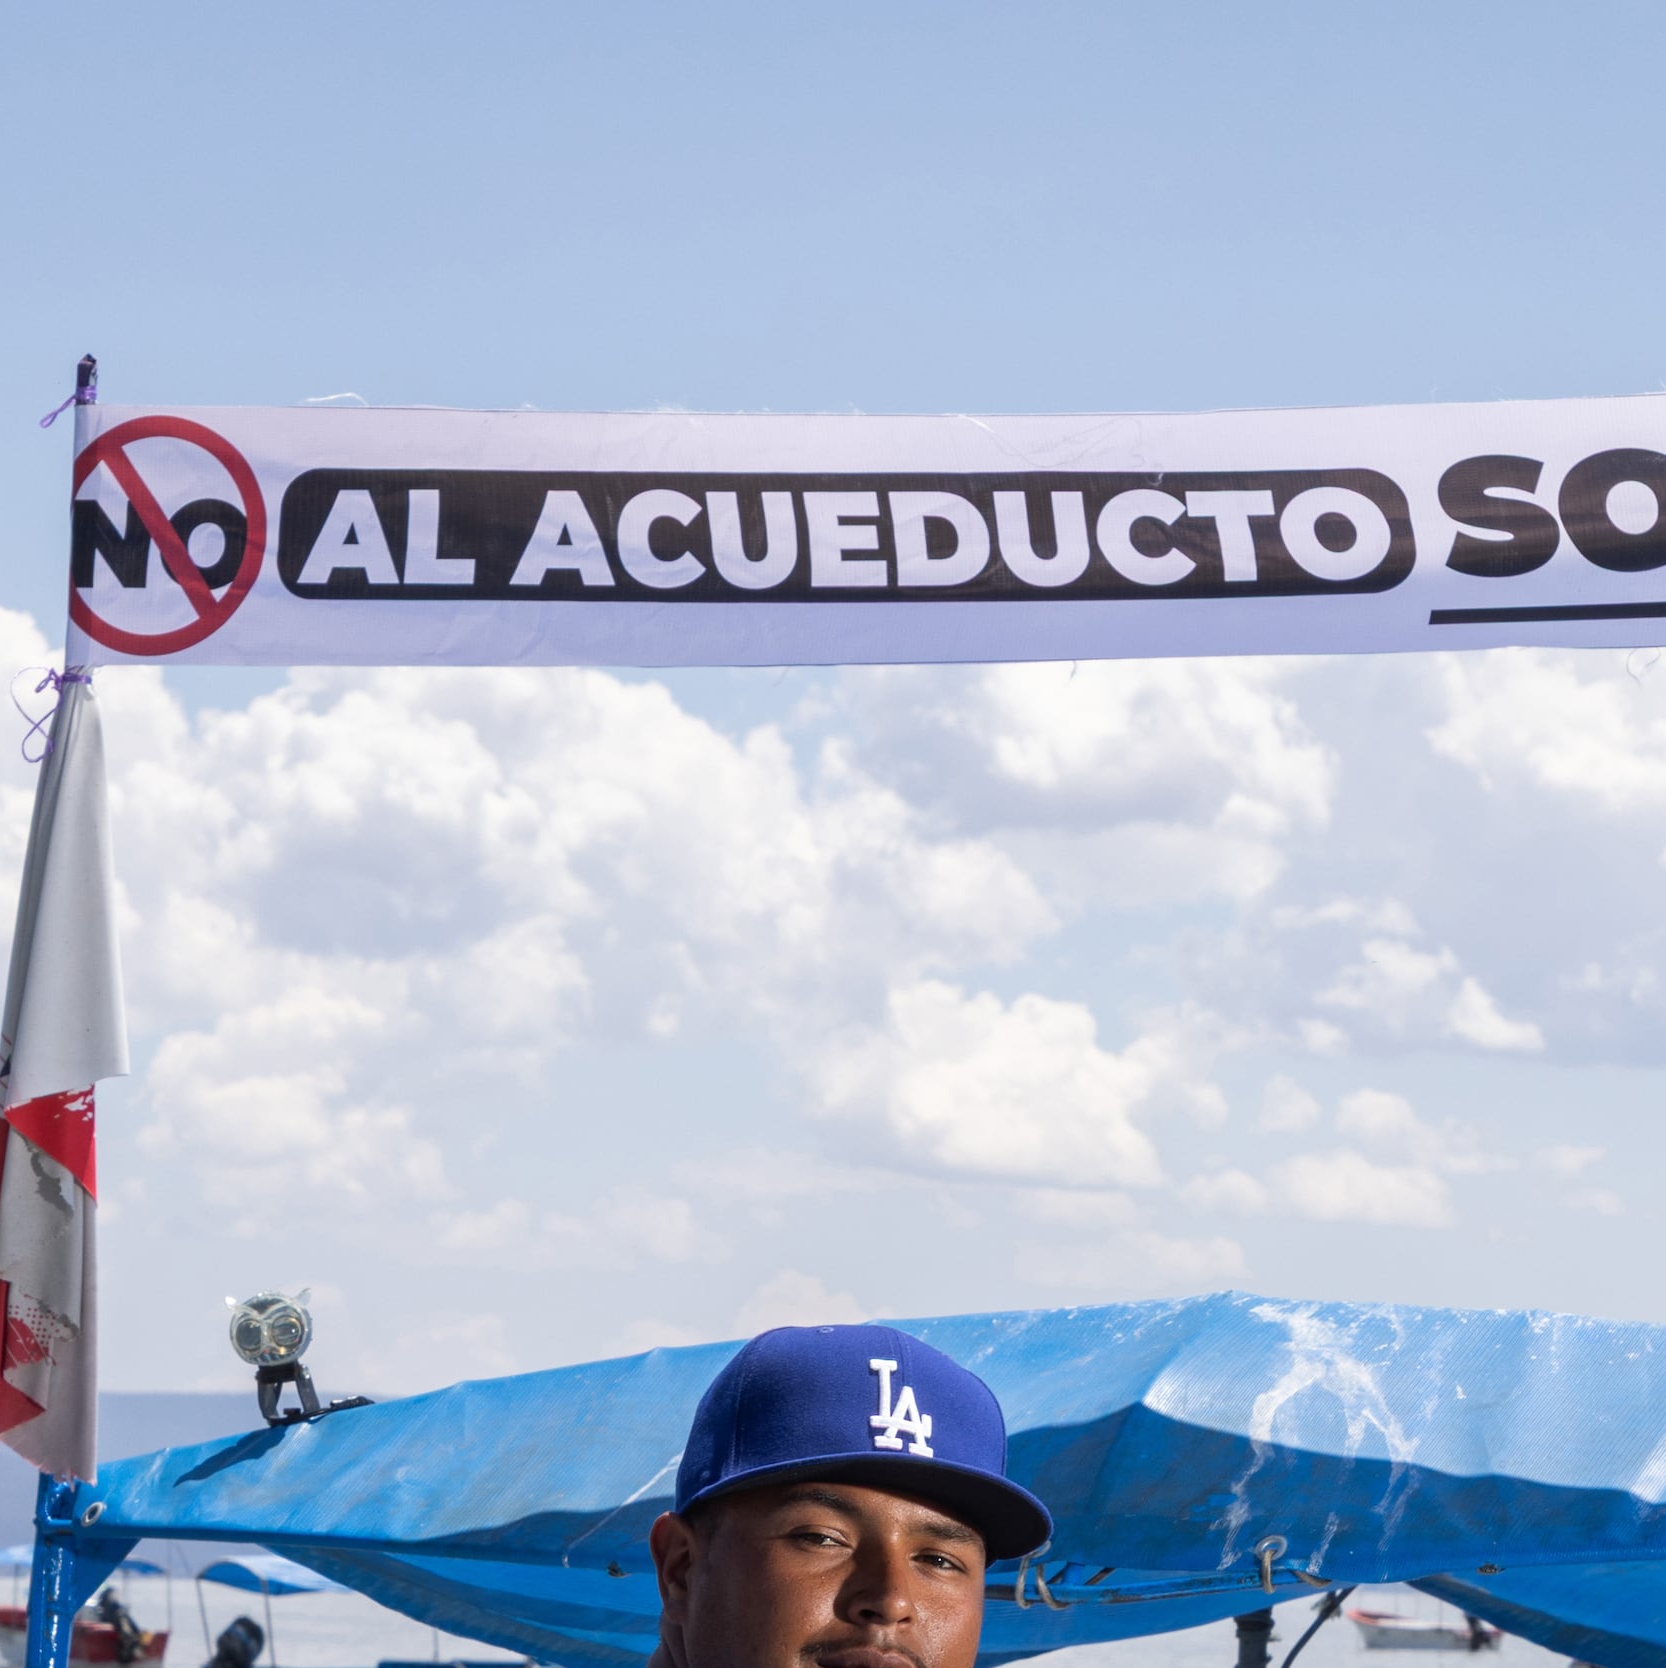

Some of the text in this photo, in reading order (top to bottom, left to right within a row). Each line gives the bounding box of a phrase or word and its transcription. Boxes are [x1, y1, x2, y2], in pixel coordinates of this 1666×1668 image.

[71, 495, 247, 590] NO
[297, 487, 476, 588] AL
[509, 484, 1393, 590] ACUEDUCTO
[869, 1358, 934, 1458] LA
